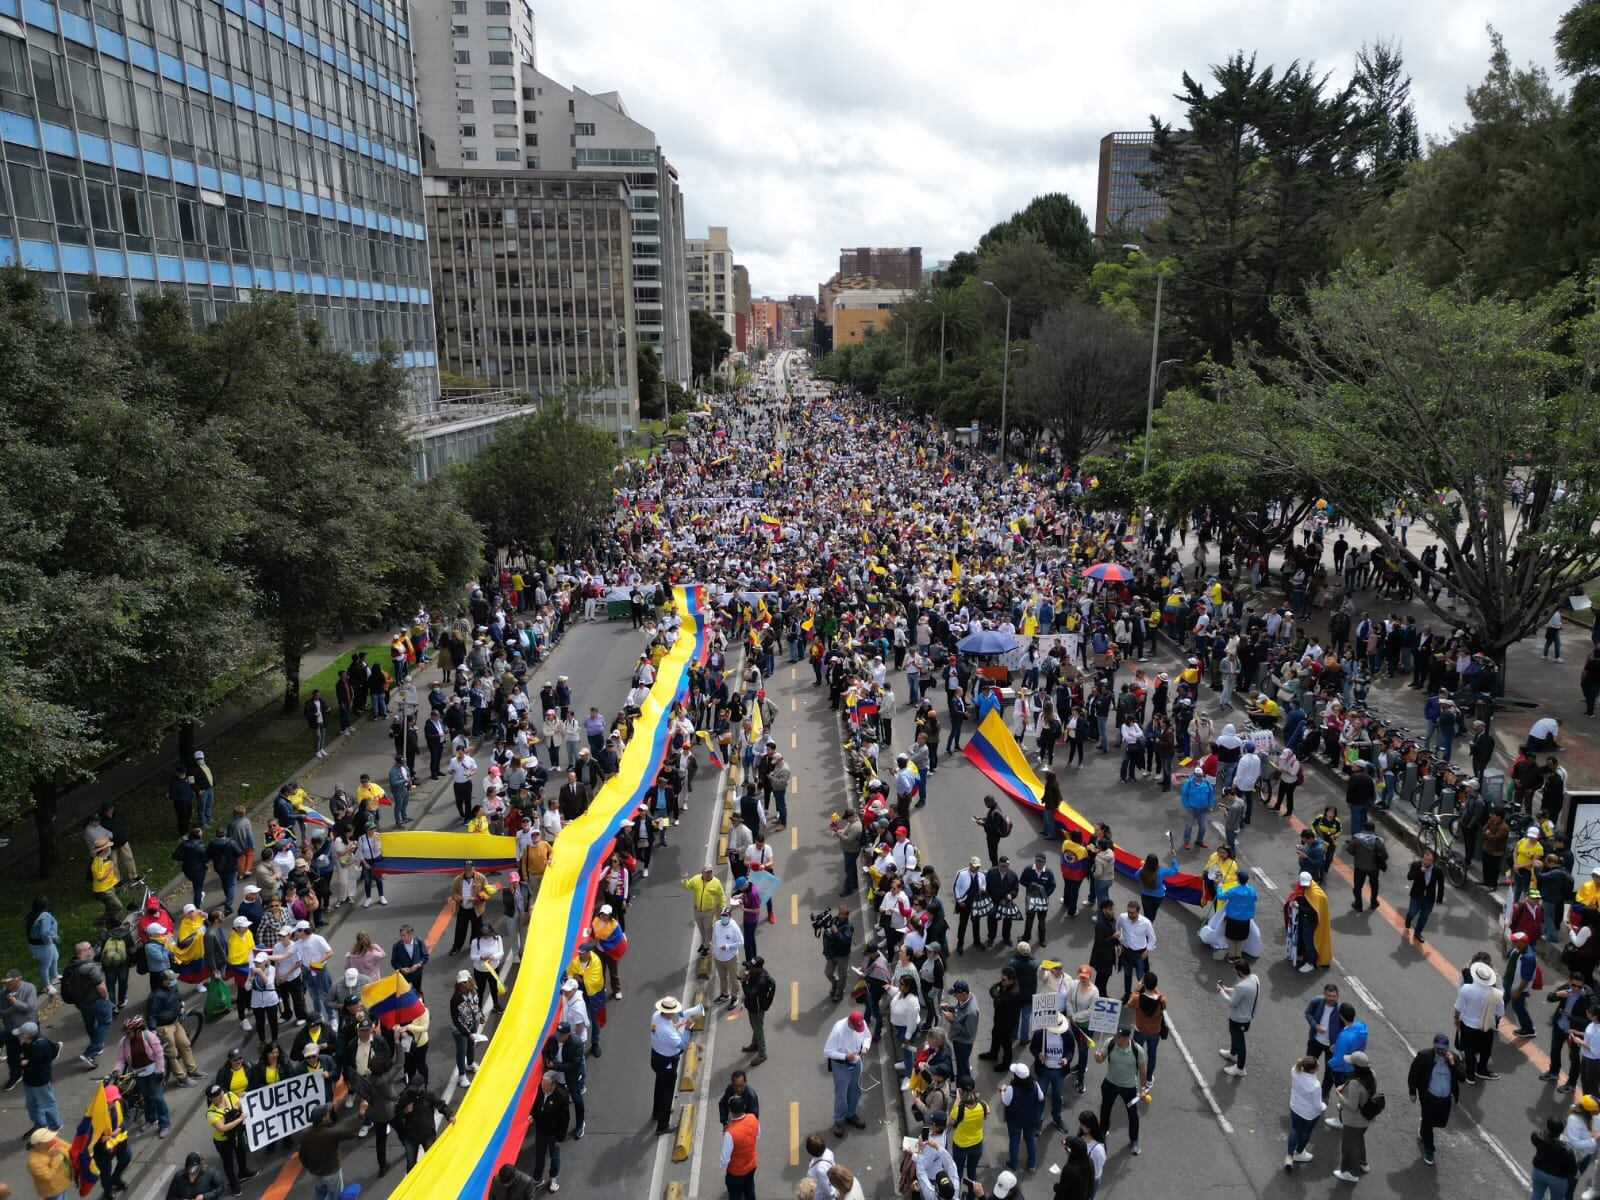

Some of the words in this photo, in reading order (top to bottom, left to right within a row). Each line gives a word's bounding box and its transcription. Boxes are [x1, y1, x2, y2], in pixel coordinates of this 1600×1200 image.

[1036, 995, 1056, 1009] NO
[1094, 1000, 1119, 1014] SI
[246, 1075, 319, 1118] FUERA
